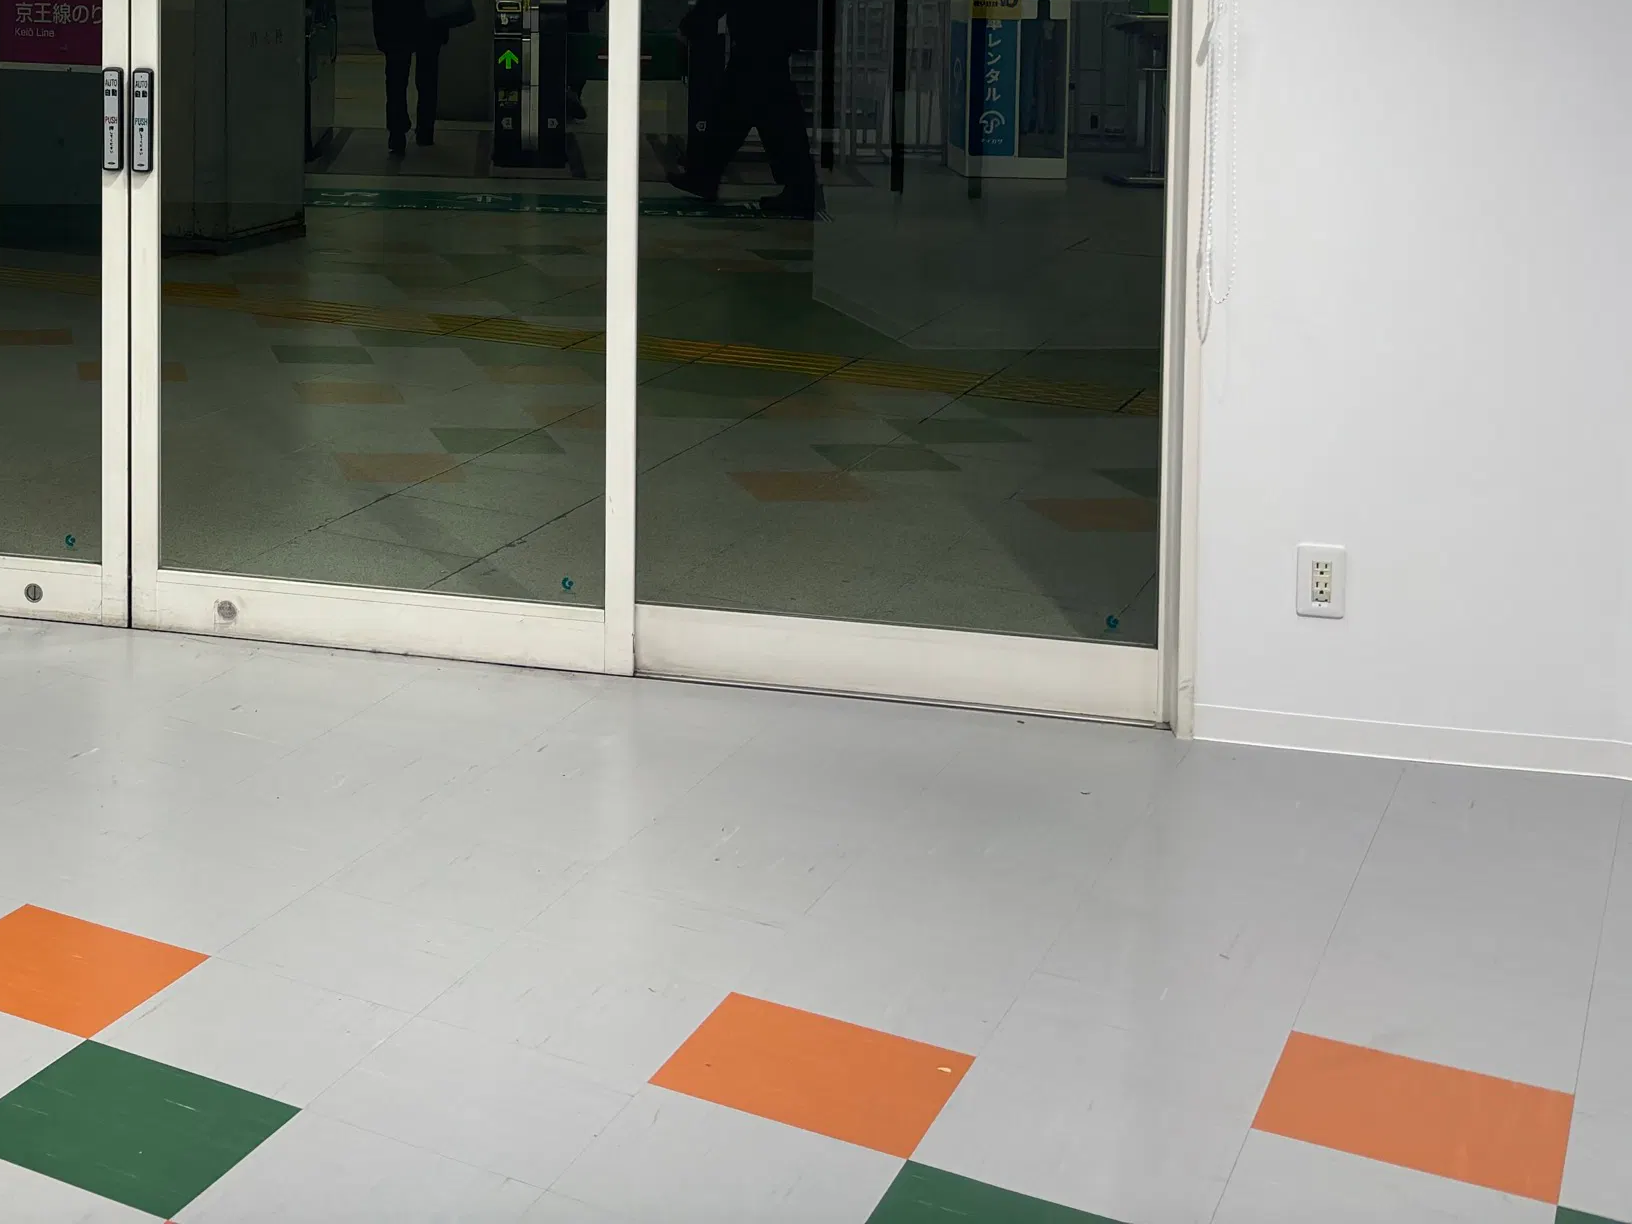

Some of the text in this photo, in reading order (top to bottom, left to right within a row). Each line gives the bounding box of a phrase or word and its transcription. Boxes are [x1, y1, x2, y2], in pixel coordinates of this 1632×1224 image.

[36, 28, 55, 38] Line
[105, 79, 118, 87] AUTO
[104, 116, 118, 124] PUSH
[134, 118, 148, 126] PUSH
